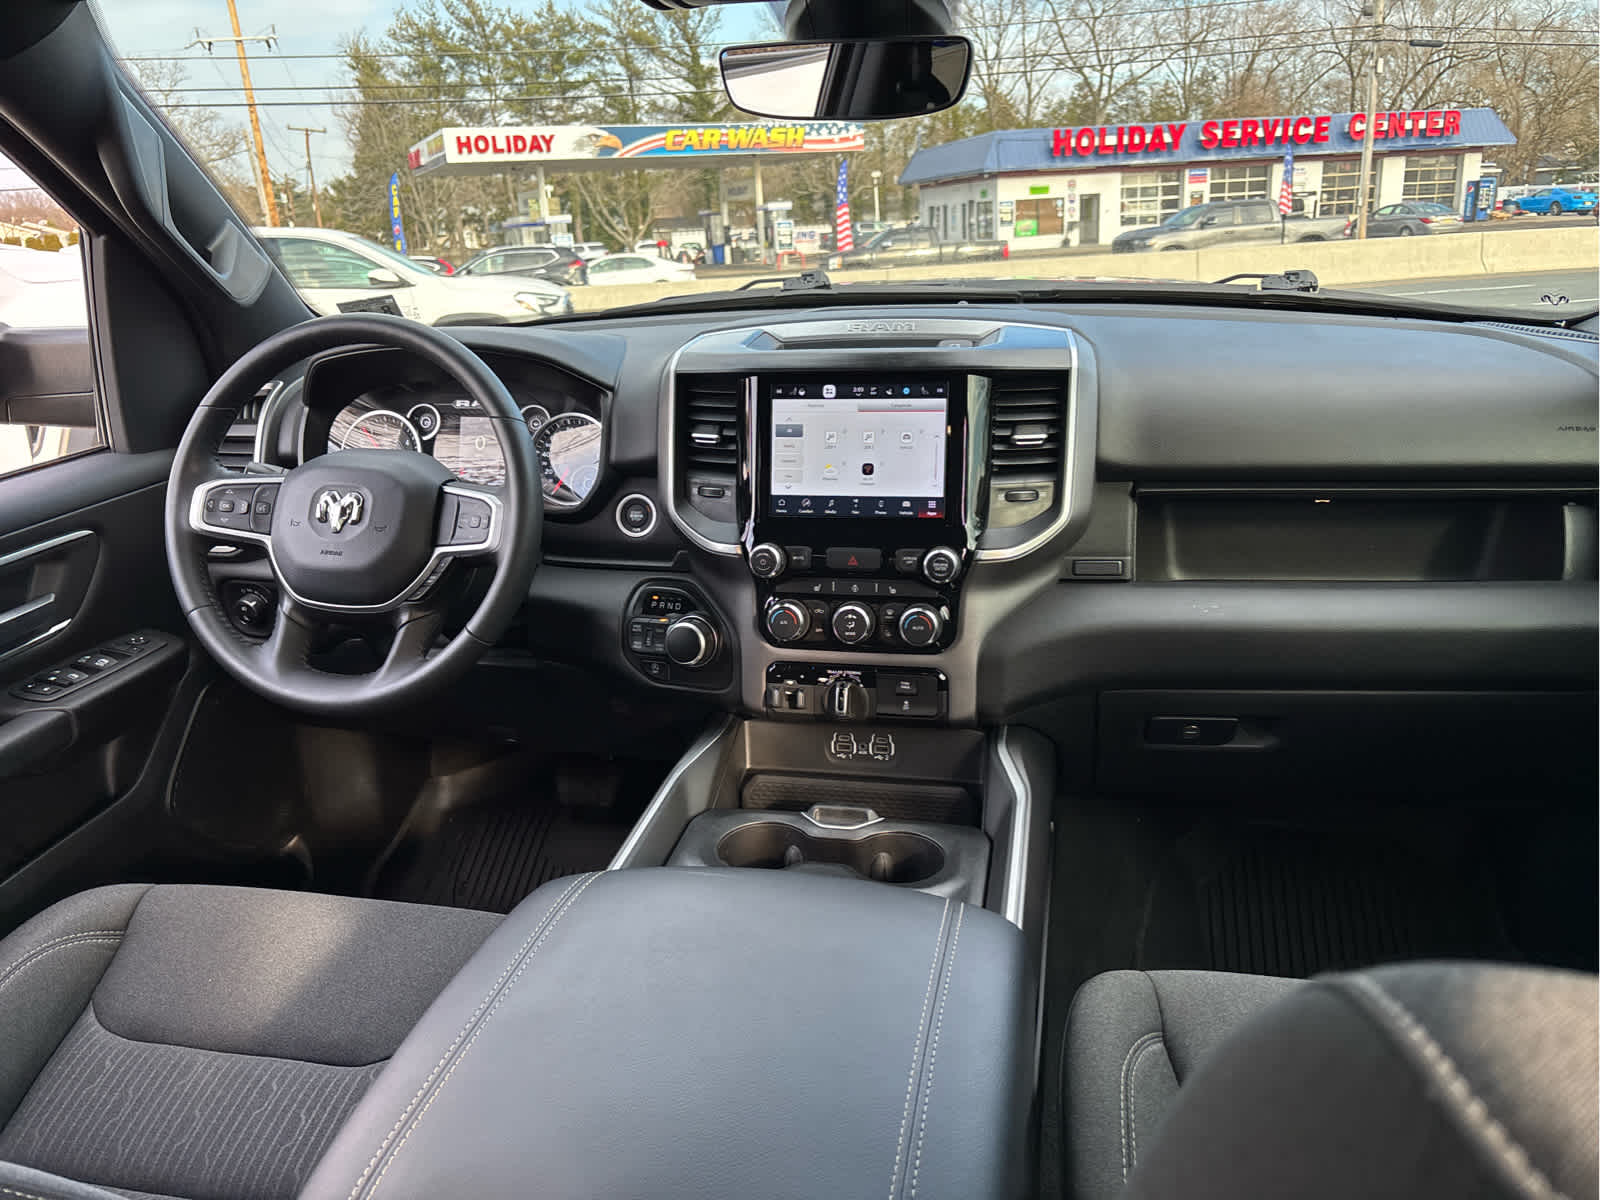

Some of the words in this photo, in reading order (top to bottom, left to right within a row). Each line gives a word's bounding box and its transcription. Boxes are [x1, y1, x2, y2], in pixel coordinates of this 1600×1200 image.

[456, 134, 555, 155] HOLIDAY
[664, 127, 721, 150] CAR
[727, 126, 805, 149] WASH
[1052, 123, 1187, 157] HOLIDAY
[1201, 115, 1331, 150] SERVICE
[1350, 110, 1461, 141] CENTER
[848, 321, 917, 333] RAM
